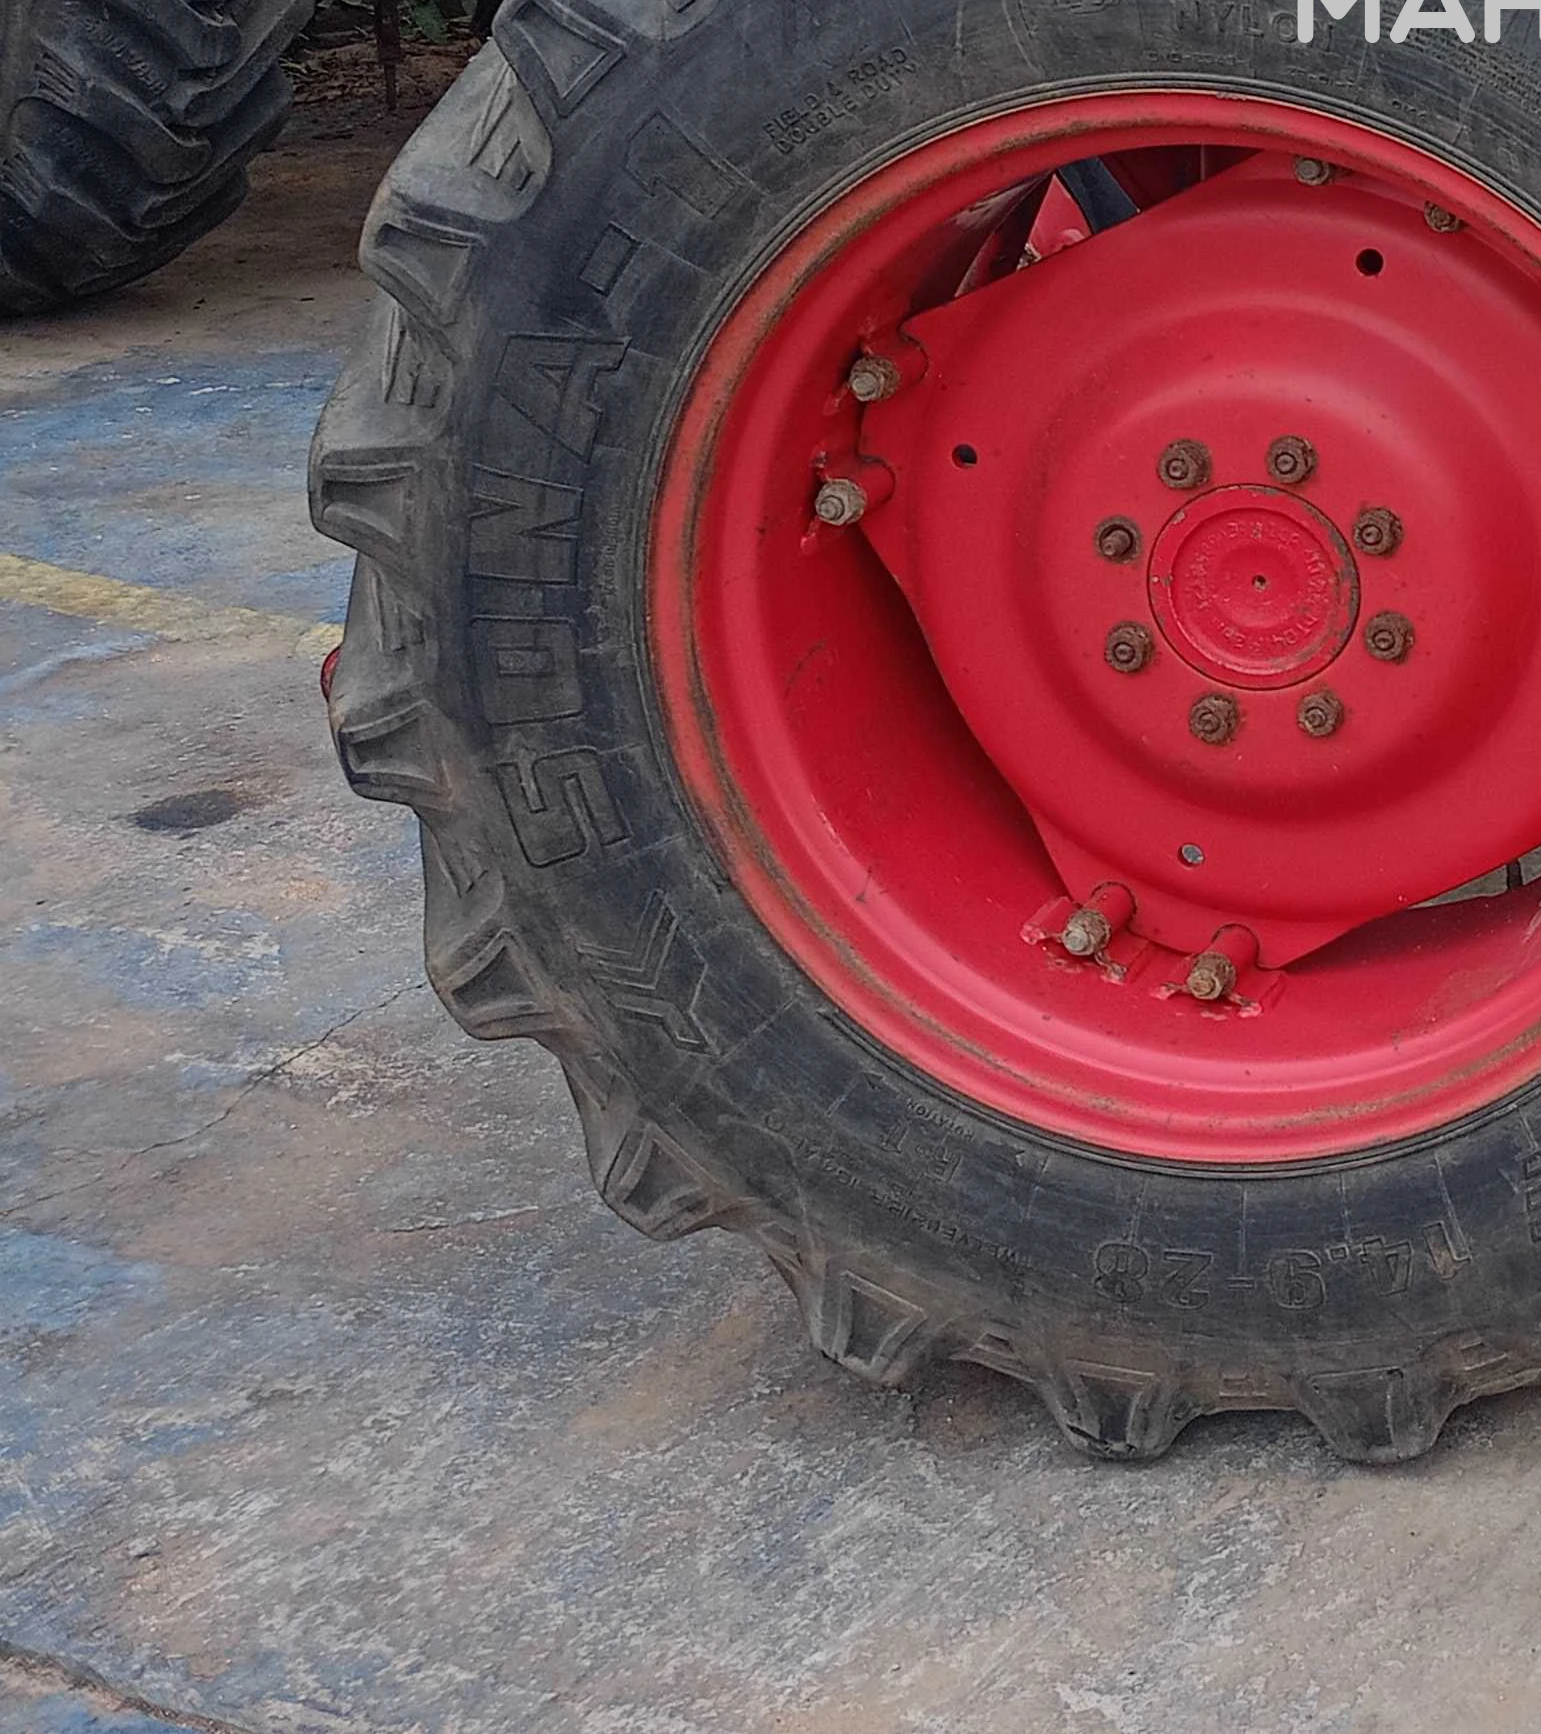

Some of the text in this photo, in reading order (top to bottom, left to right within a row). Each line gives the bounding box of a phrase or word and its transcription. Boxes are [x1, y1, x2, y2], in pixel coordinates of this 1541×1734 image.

[763, 92, 821, 140] FIELD
[847, 46, 907, 84] ROAD
[774, 98, 858, 154] DOUBLE
[1092, 1215, 1473, 1313] 14.9-28
